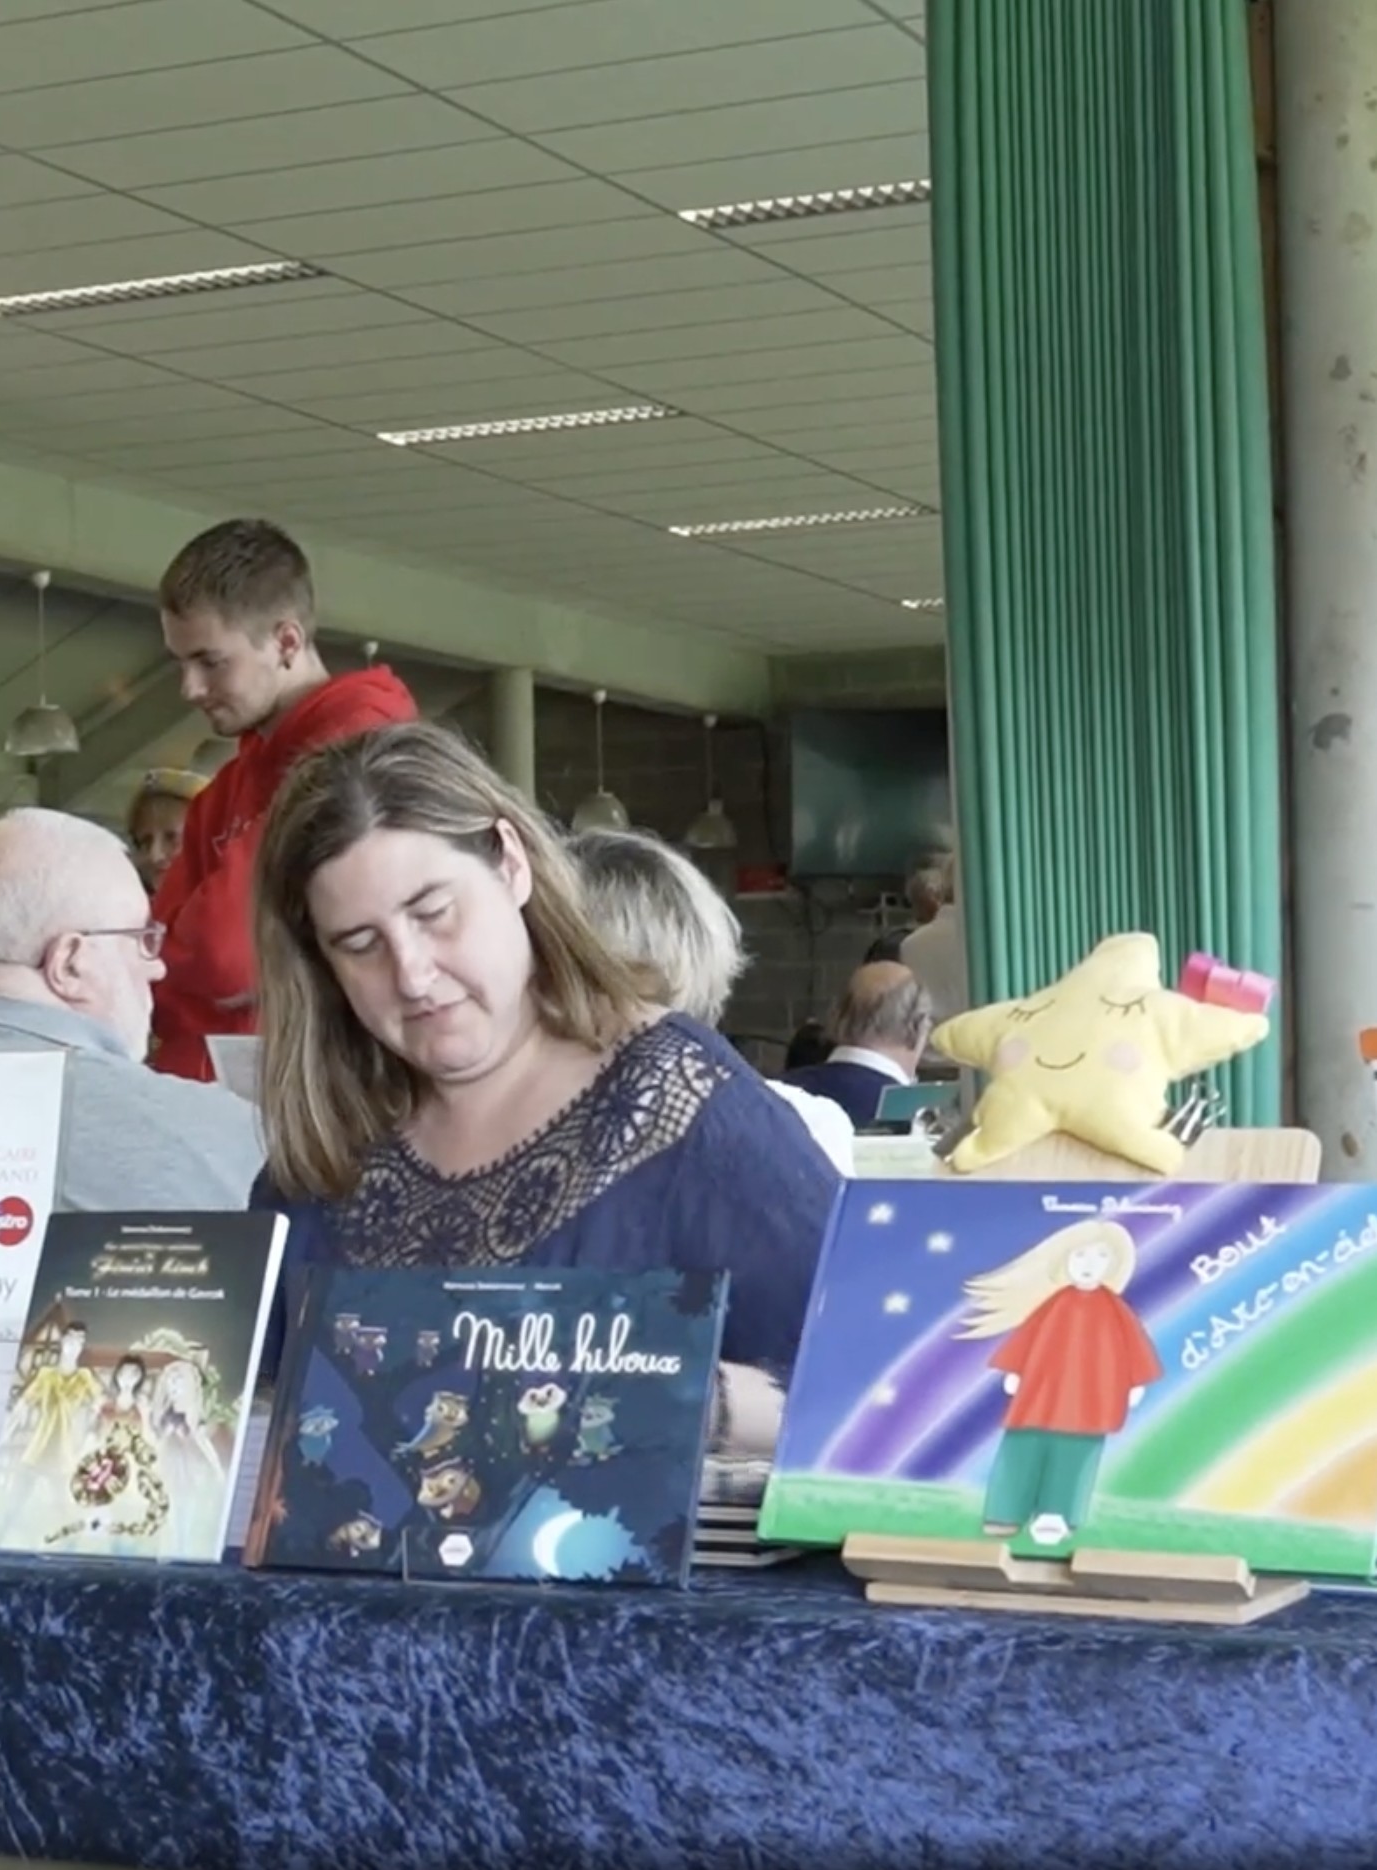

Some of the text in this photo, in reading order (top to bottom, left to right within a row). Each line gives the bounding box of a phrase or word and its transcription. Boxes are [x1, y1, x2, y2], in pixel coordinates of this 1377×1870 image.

[1189, 1214, 1287, 1284] Bout
[452, 1311, 681, 1375] Mille hiboux
